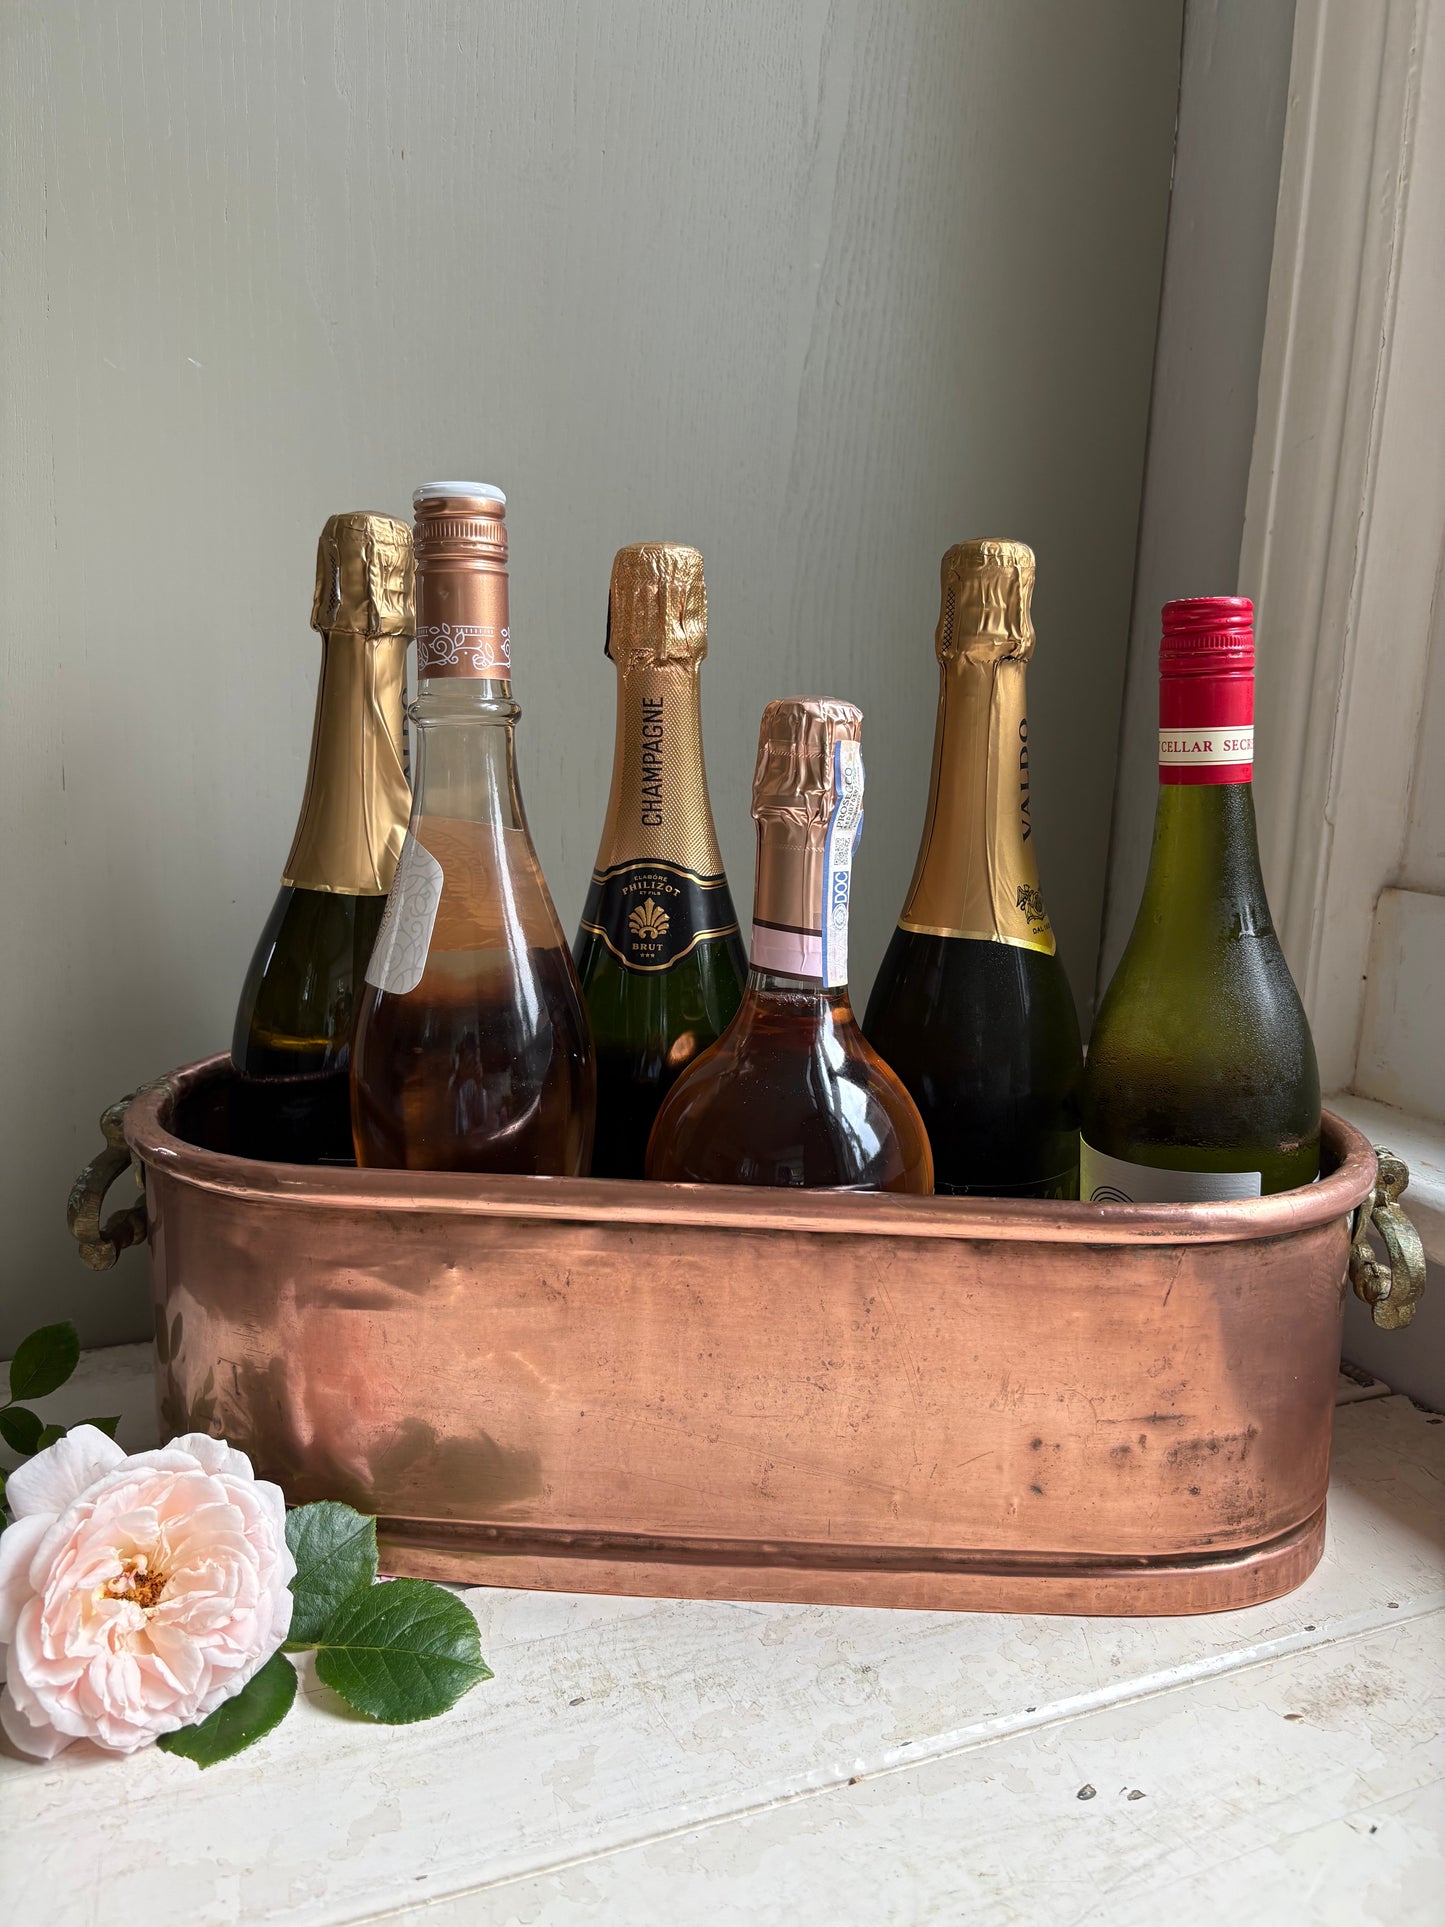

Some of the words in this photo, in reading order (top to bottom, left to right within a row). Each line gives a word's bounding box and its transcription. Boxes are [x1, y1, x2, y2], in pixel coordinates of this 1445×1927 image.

[641, 697, 663, 827] CHAMPAGNE
[1161, 741, 1213, 753] CELLAR
[1019, 718, 1032, 842] VALDO
[836, 767, 854, 829] PROSECCO
[622, 881, 681, 897] PHILIZOT
[834, 871, 848, 904] DOC
[632, 943, 664, 951] BRUT
